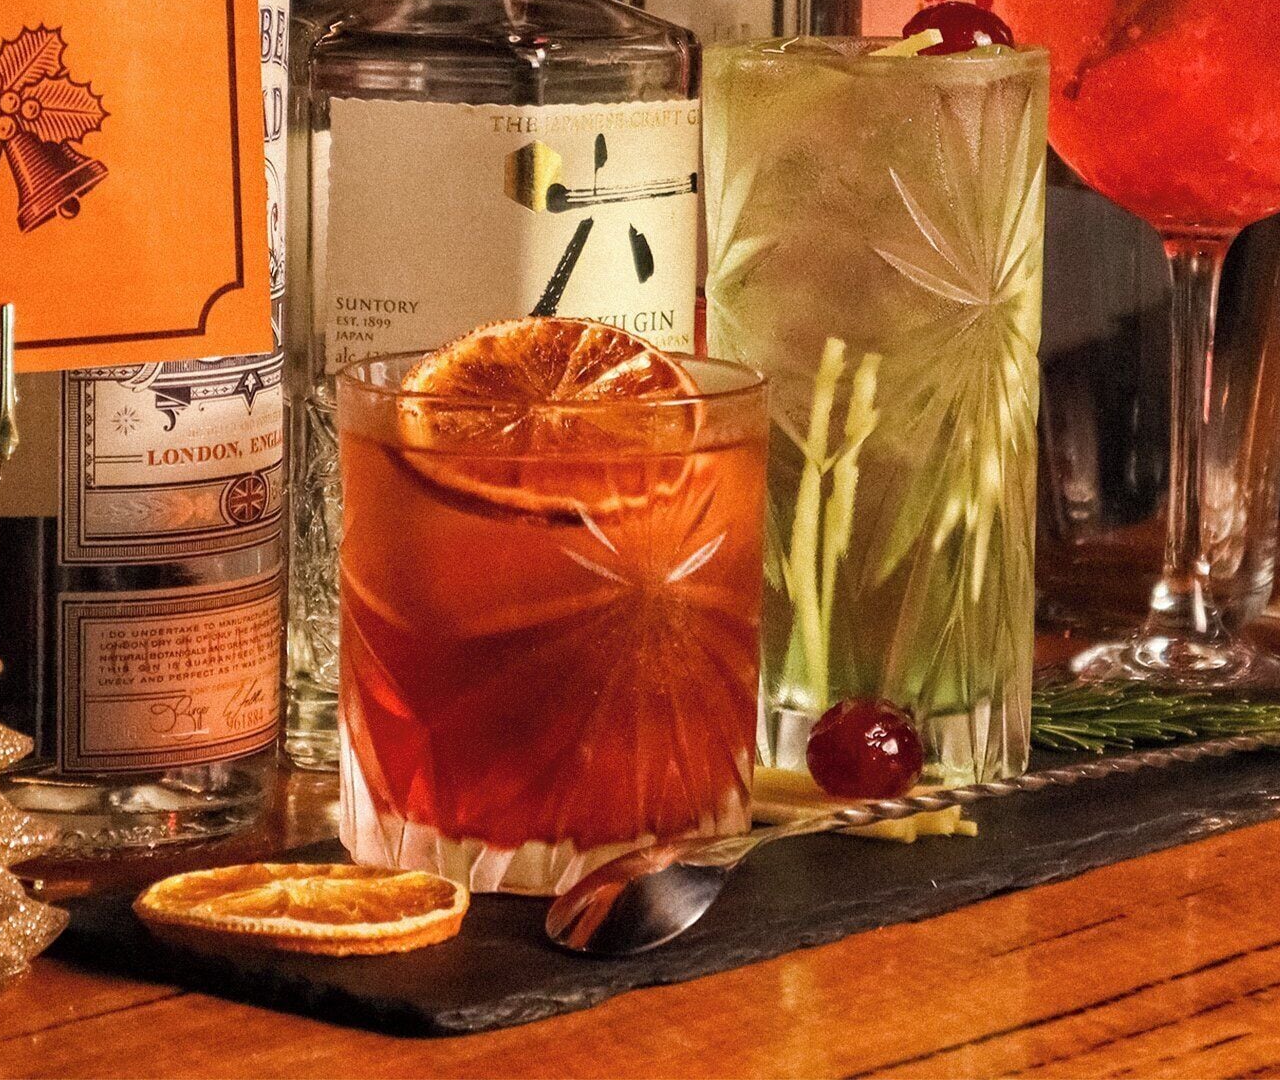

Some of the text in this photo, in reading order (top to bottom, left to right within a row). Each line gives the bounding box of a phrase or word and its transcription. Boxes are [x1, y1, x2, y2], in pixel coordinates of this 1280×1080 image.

[489, 115, 538, 133] THE
[687, 109, 700, 125] G
[336, 297, 418, 313] SUNTORY
[336, 316, 391, 328] EST. 1899
[634, 309, 674, 333] GIN
[336, 332, 373, 341] JAPAN
[146, 441, 243, 467] LONDON,
[109, 631, 125, 639] DO
[131, 625, 199, 638] UNDERTAKE
[99, 641, 146, 650] LONDON
[151, 639, 172, 648] DRY
[98, 677, 134, 686] LIVELY
[140, 675, 164, 684] AND
[169, 669, 215, 681] PERFECT
[218, 666, 229, 674] AS
